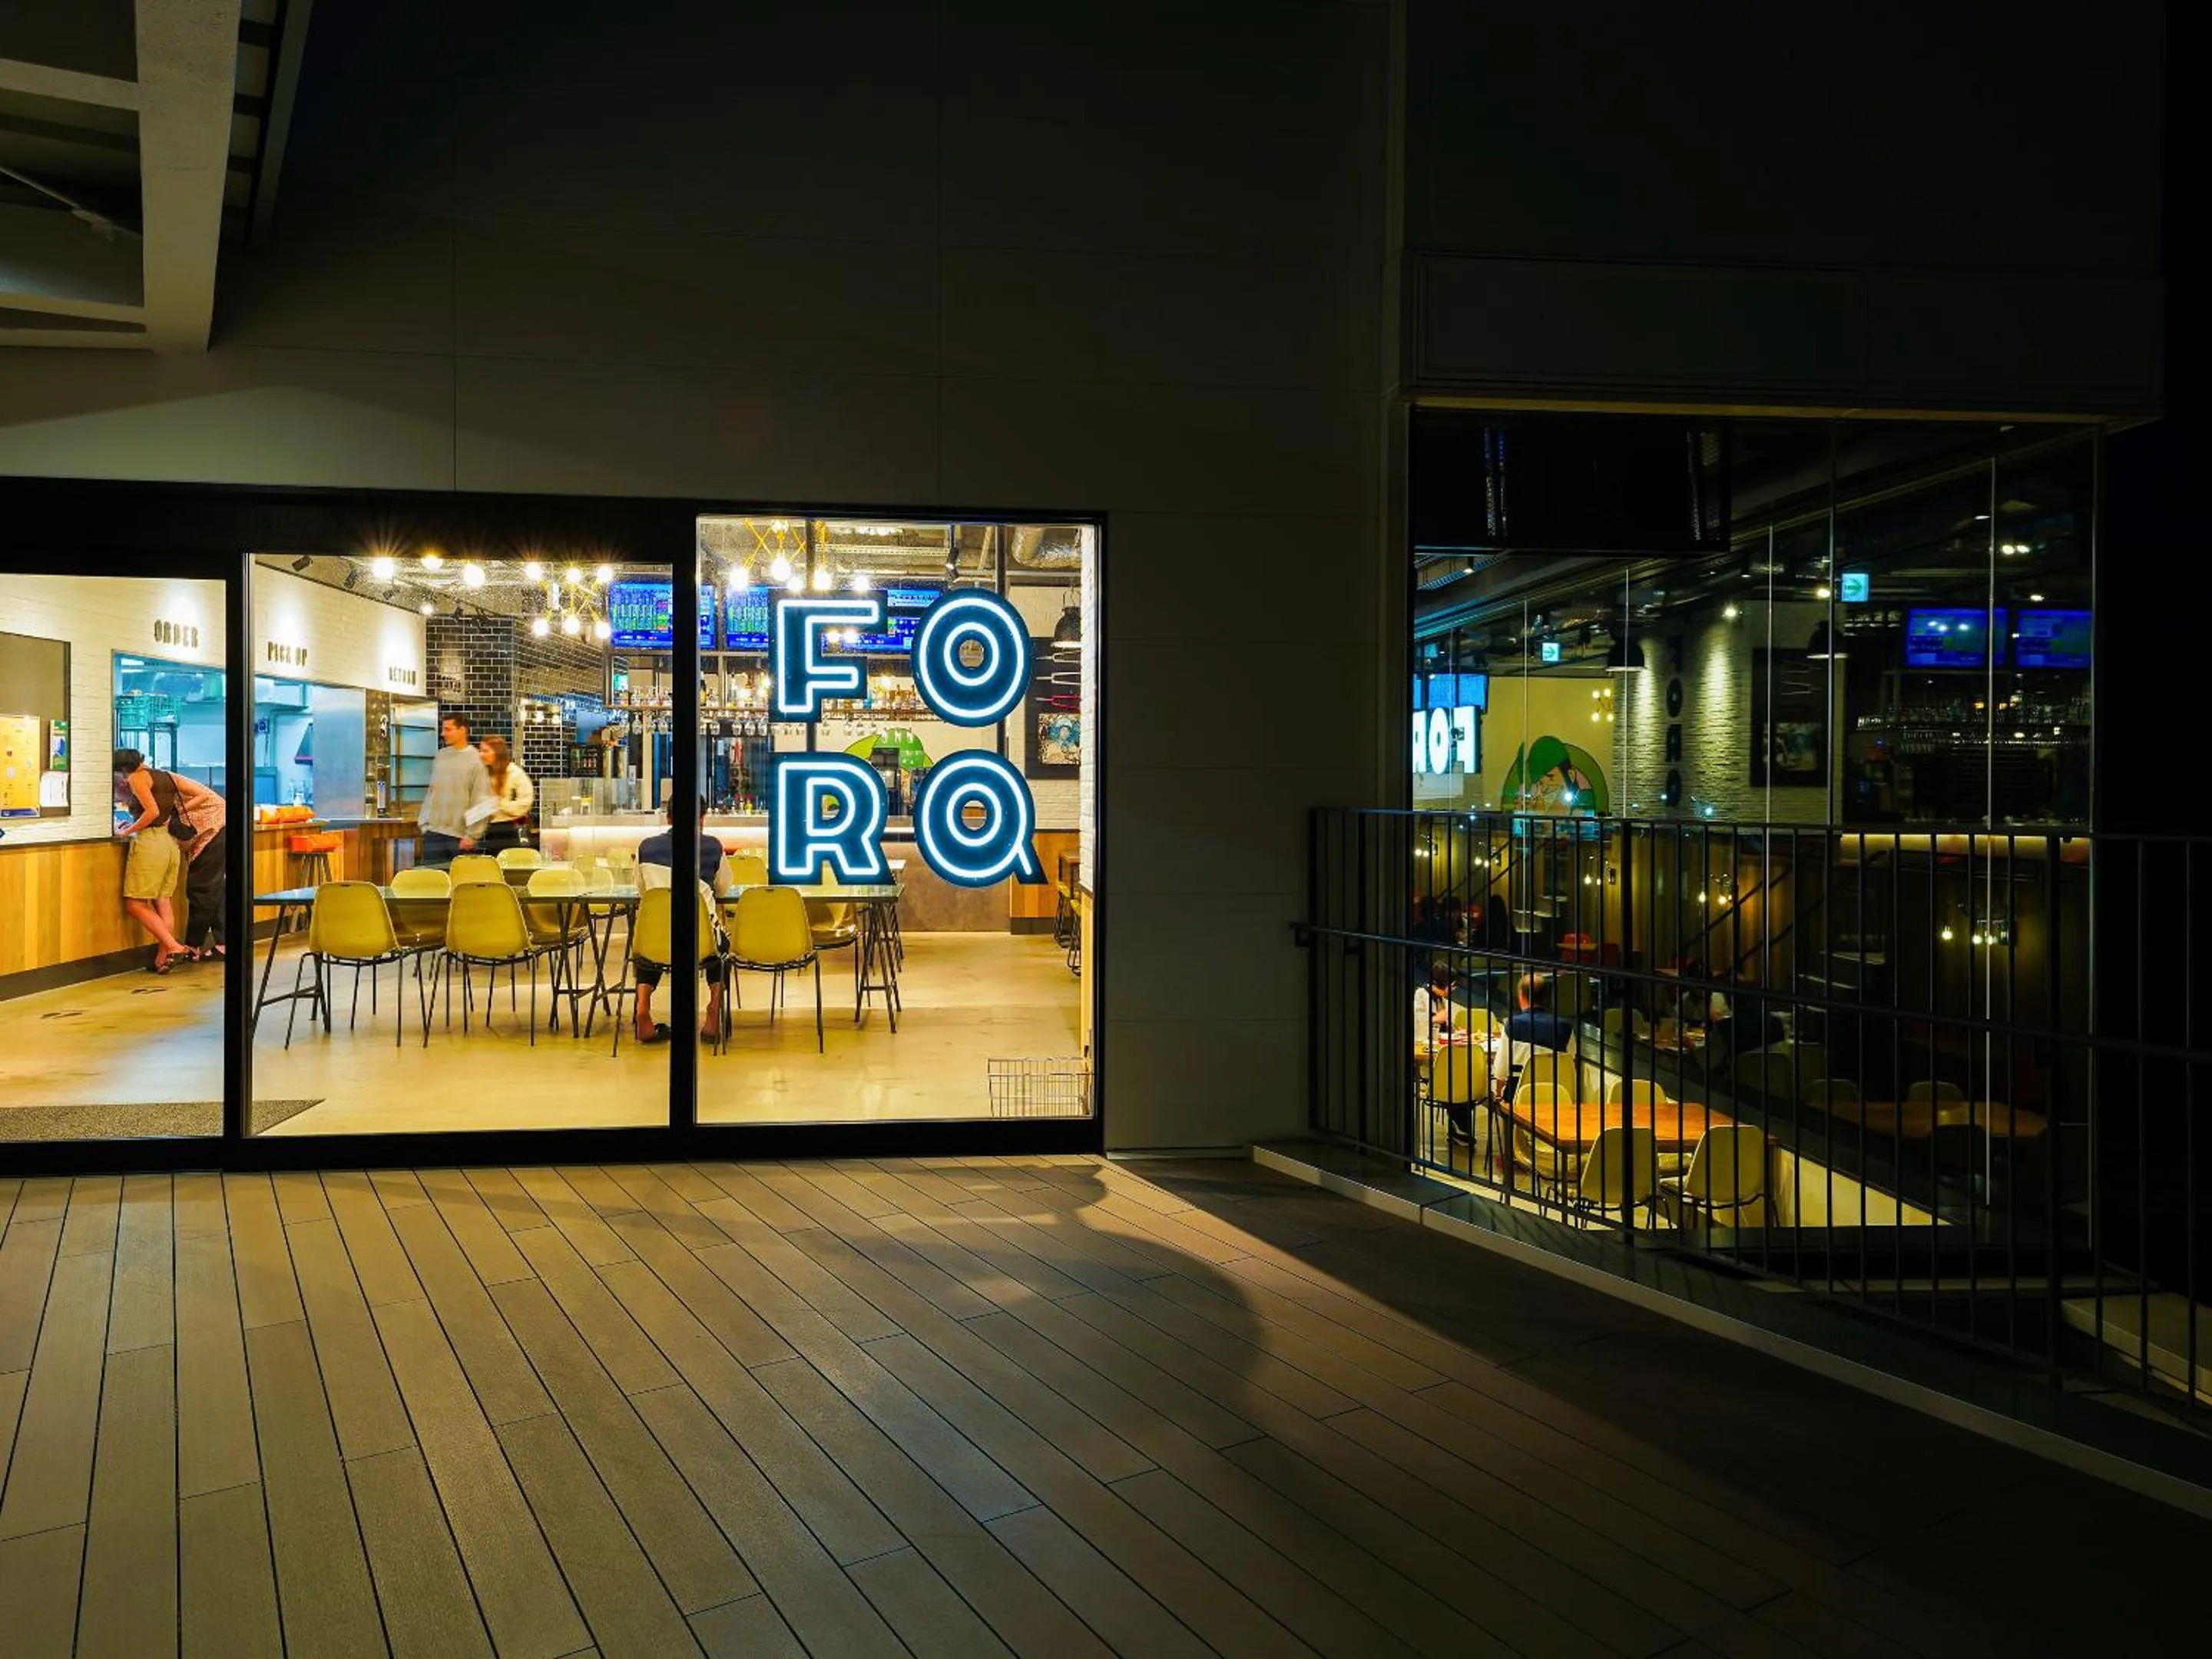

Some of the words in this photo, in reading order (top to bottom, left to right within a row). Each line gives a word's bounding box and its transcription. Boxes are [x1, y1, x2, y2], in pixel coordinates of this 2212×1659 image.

[154, 619, 199, 648] ORDER
[267, 641, 291, 664] PICK
[296, 647, 307, 667] UP
[769, 589, 1033, 727] FO
